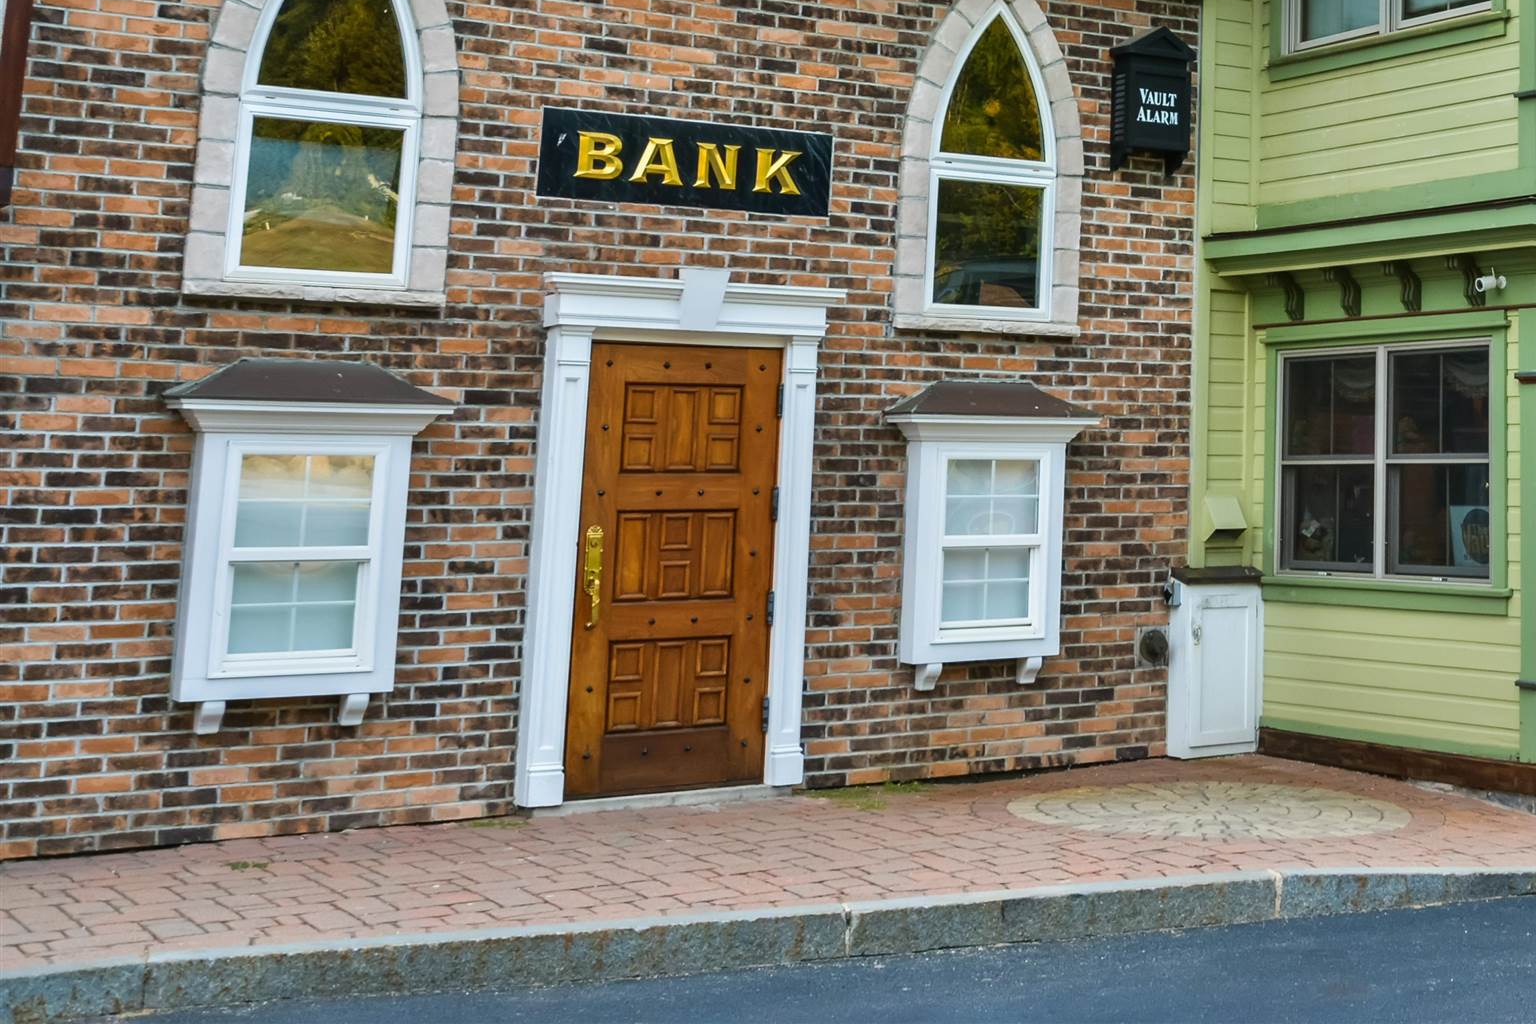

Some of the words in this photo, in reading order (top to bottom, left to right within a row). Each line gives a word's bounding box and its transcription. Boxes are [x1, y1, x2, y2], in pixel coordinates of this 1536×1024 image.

[1139, 87, 1177, 107] VAULT
[1136, 106, 1179, 125] ALARM
[573, 130, 803, 196] BANK
